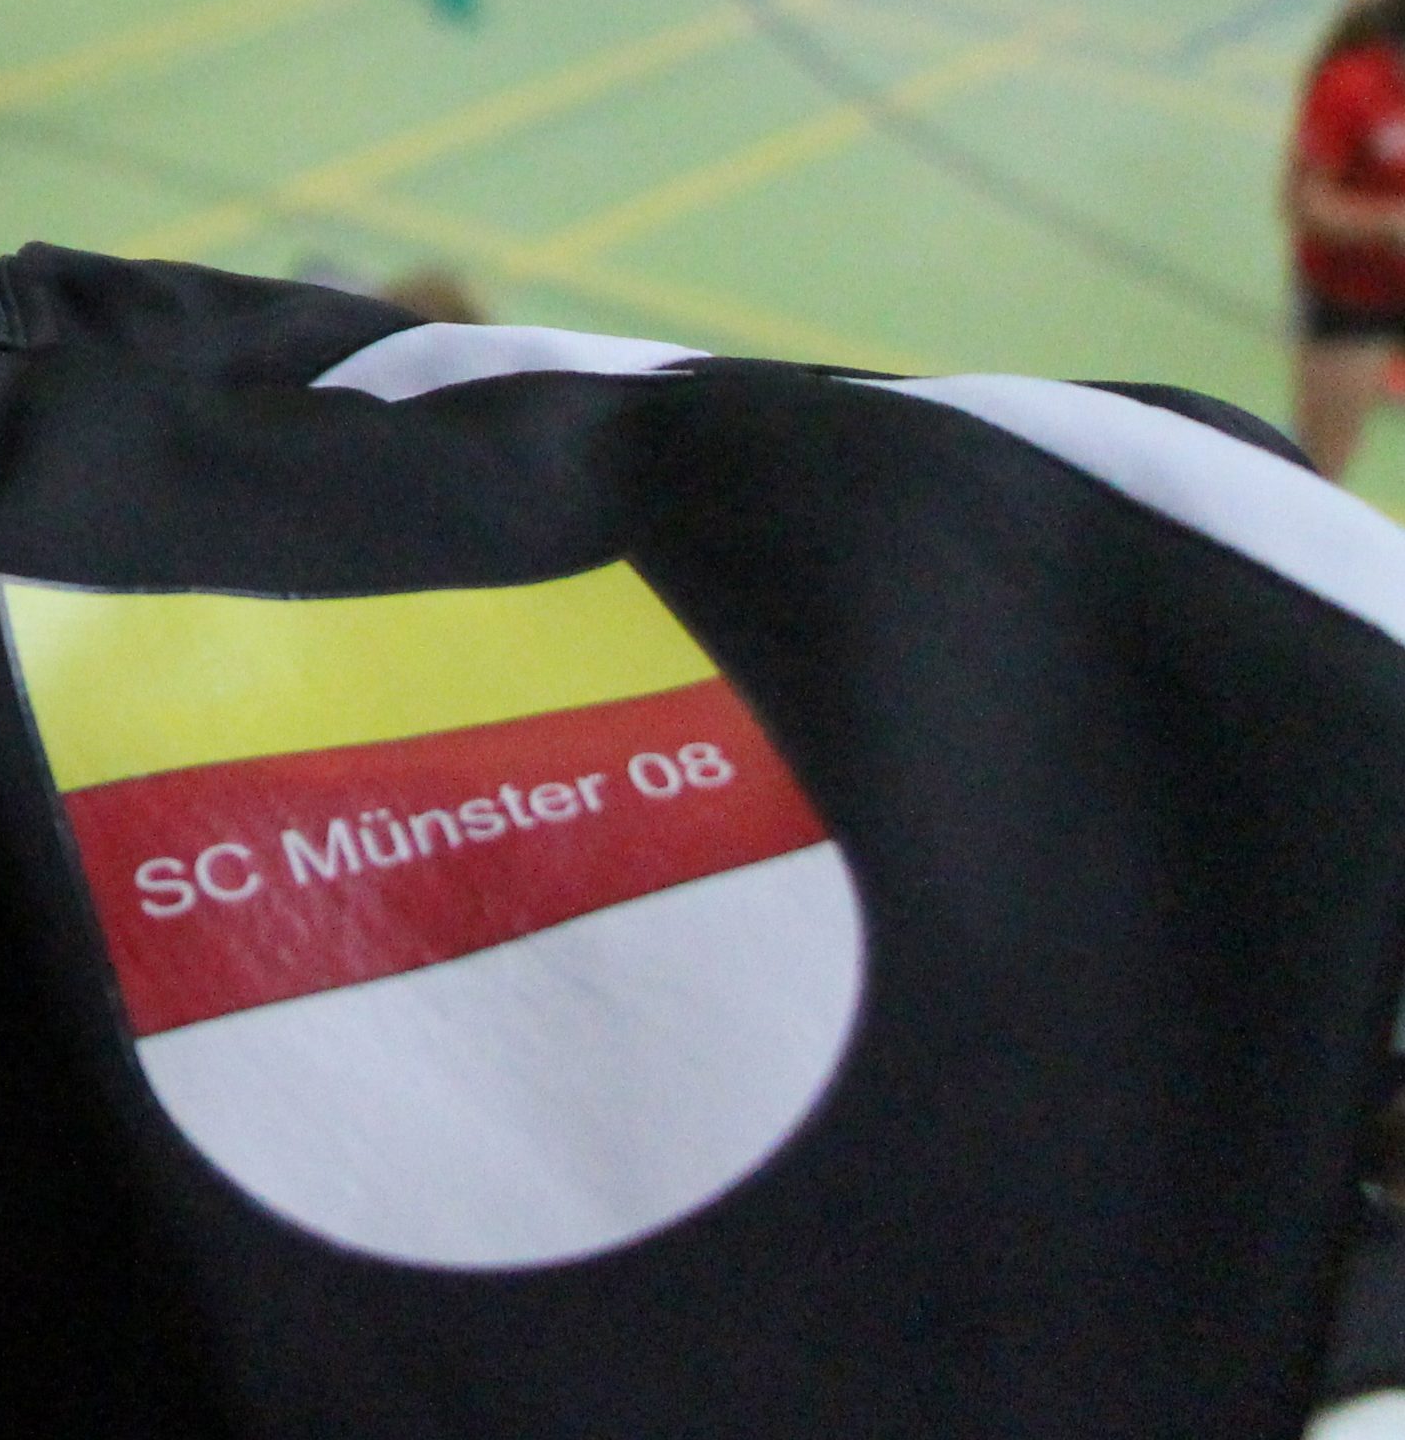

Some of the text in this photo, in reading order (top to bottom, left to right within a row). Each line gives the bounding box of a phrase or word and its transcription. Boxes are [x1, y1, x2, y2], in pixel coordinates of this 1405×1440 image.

[132, 741, 735, 920] SC Münster 08
